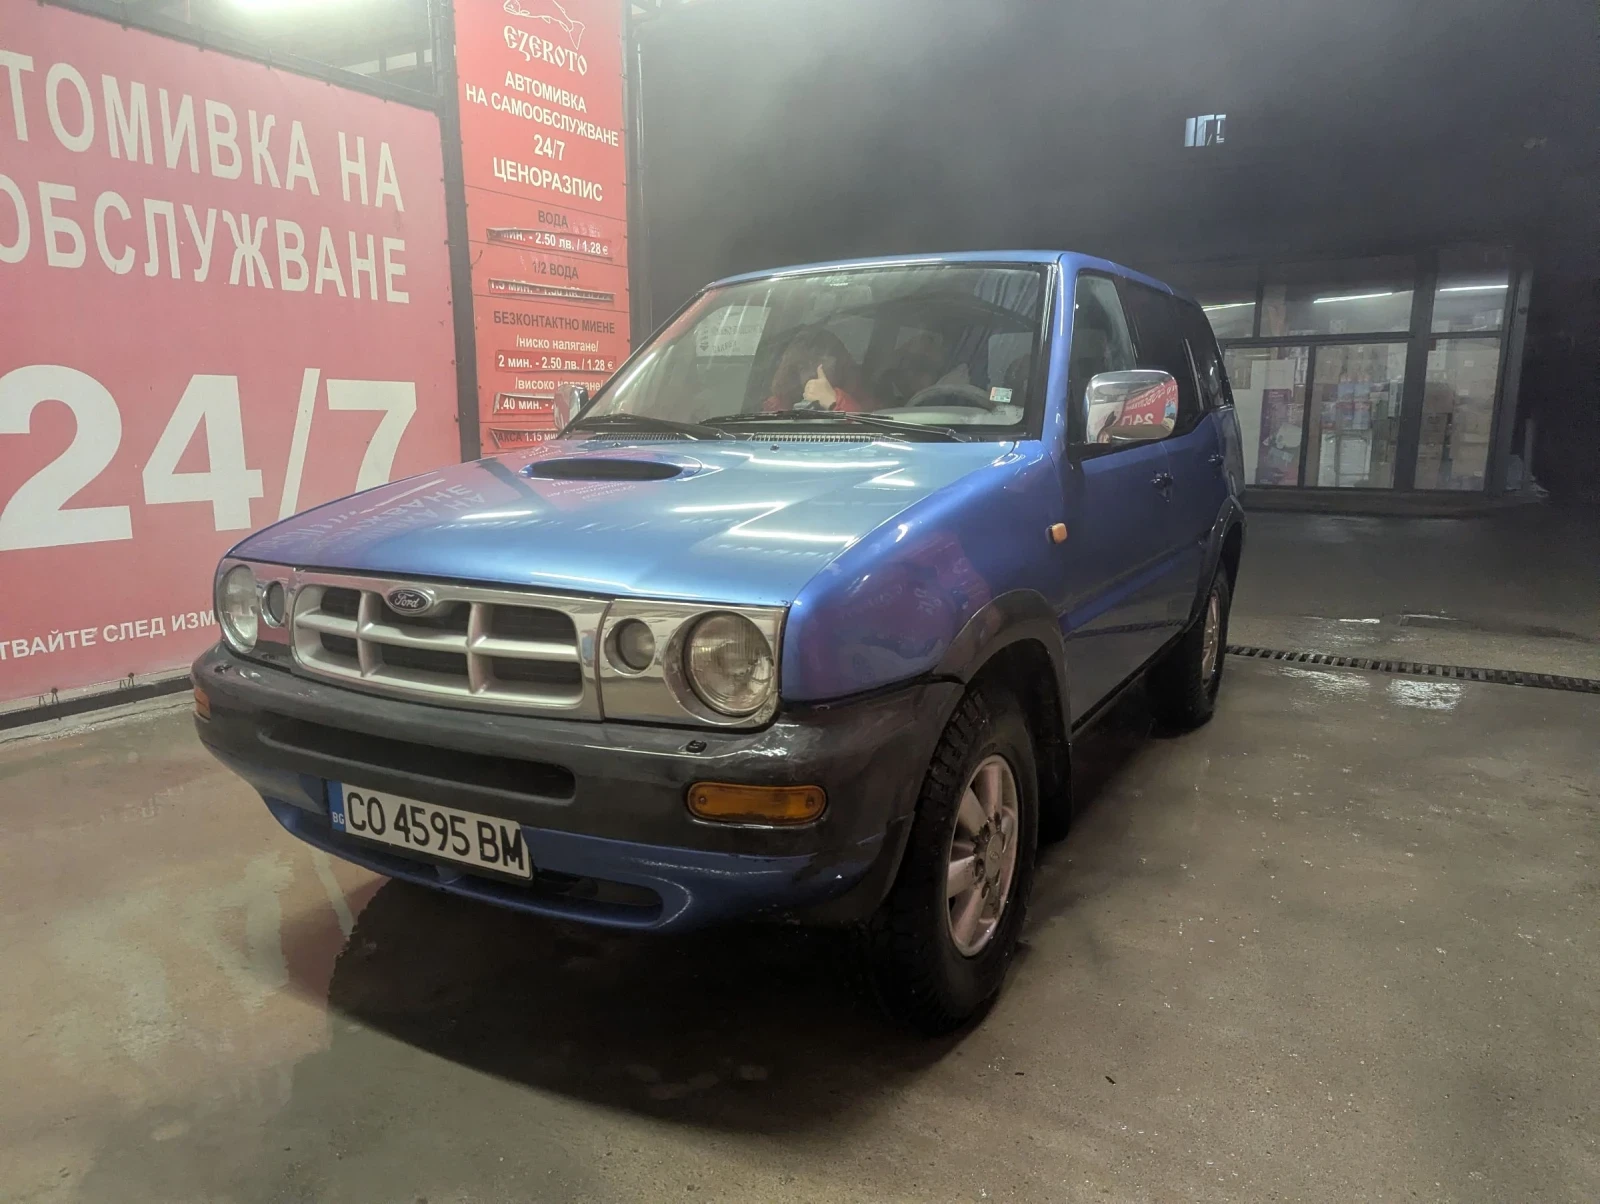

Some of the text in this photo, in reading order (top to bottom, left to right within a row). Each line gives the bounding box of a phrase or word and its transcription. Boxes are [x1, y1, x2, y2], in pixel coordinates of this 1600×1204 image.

[505, 71, 587, 113] АВТОМИВКА
[465, 83, 619, 147] НА САМООБСЛУЖВАНЕ
[0, 49, 405, 212] ТОМИВКА НА
[533, 134, 565, 161] 24/7
[493, 157, 603, 202] ЦЕНОРАЗПИС
[538, 210, 568, 228] ВОДА
[535, 233, 556, 247] 2.50
[559, 238, 574, 250] лв.
[582, 241, 601, 255] 1.28
[602, 245, 609, 255] €
[533, 261, 579, 280] 1/2 ВОДА
[493, 310, 616, 335] БЕЗКОНТАКТНО МИЕНЕ
[516, 335, 599, 352] /ниско налягане/
[498, 355, 505, 367] 2
[508, 358, 533, 369] мин.
[541, 357, 562, 370] 2.50
[564, 360, 580, 370] лв.
[587, 358, 605, 372] 1.28
[607, 361, 614, 370] €
[515, 377, 555, 390] /високо
[518, 401, 542, 410] мин.
[524, 431, 543, 442] 1.15
[0, 364, 417, 551] 24/7
[394, 592, 420, 608] Ford
[103, 618, 166, 643] СЛЕД
[171, 610, 216, 632] ИЗМ
[332, 792, 525, 871] BG CO 4595 BM
